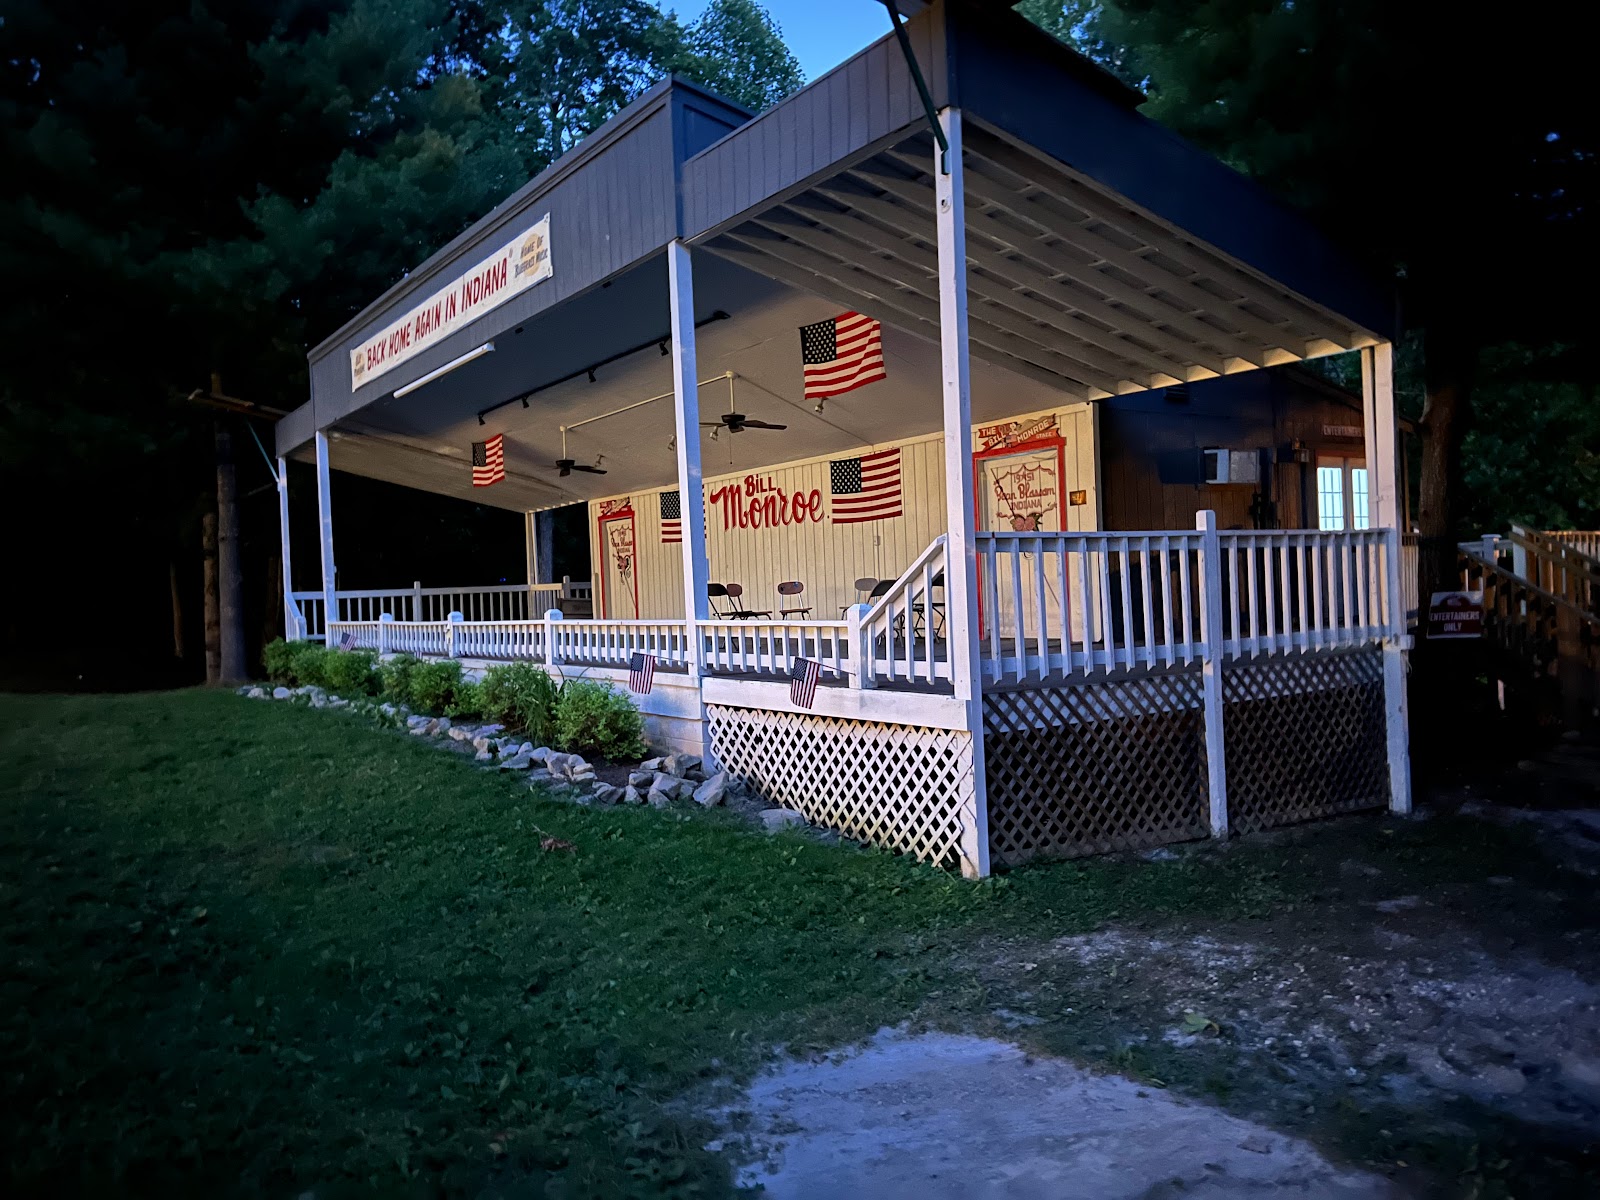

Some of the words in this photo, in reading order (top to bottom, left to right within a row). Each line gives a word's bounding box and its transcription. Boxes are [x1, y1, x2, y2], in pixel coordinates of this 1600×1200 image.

[389, 321, 411, 358] HOME
[414, 300, 442, 342] AGAIN
[444, 290, 457, 323] IN
[981, 427, 997, 437] THE
[988, 431, 1006, 447] BILL
[1017, 419, 1050, 443] MONROE
[709, 484, 825, 532] Monroe
[1011, 499, 1042, 511] INDIANA
[1430, 611, 1480, 621] ENTERTAINERS
[1443, 622, 1462, 632] ONLY
